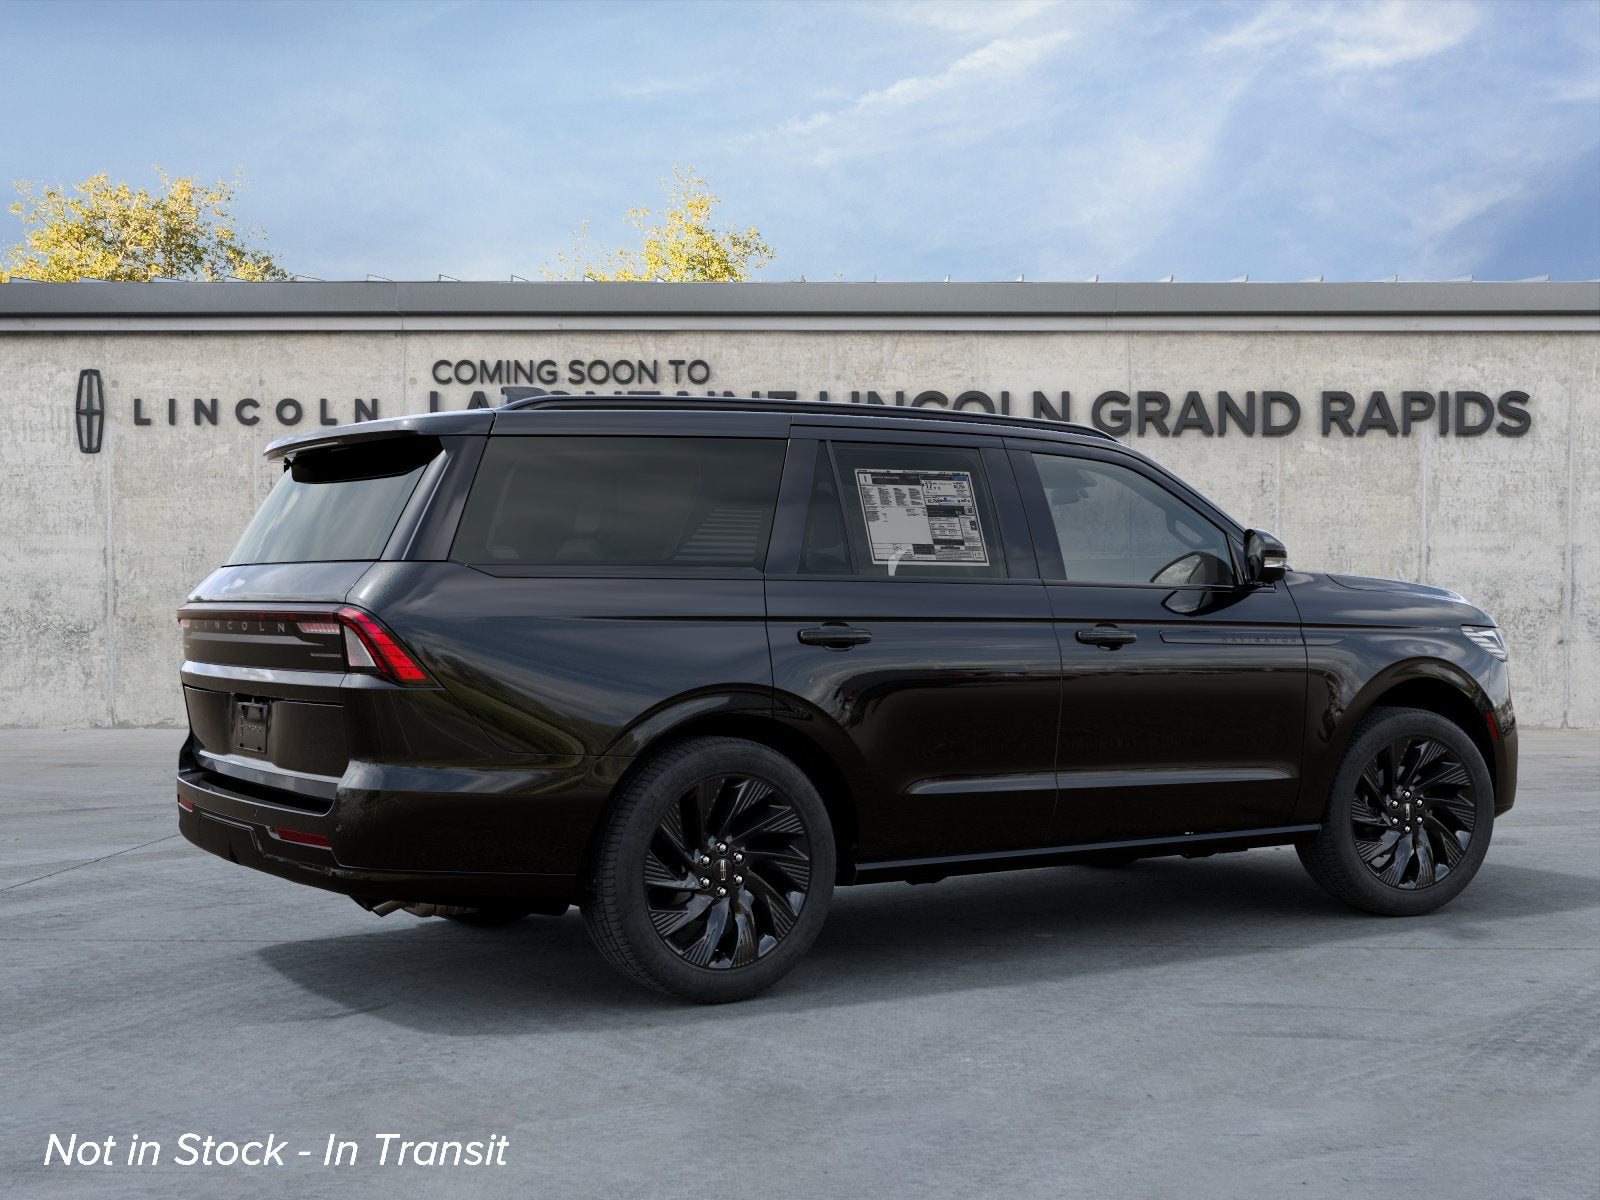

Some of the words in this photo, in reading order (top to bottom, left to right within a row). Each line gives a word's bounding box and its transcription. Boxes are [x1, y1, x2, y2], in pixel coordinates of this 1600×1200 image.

[431, 359, 558, 386] COMING
[568, 359, 658, 386] SOON
[668, 359, 711, 386] TO
[133, 397, 379, 427] LINCOLN
[1091, 390, 1301, 438] GRAND
[1321, 390, 1532, 438] RAPIDS
[194, 619, 285, 633] LINCOLN
